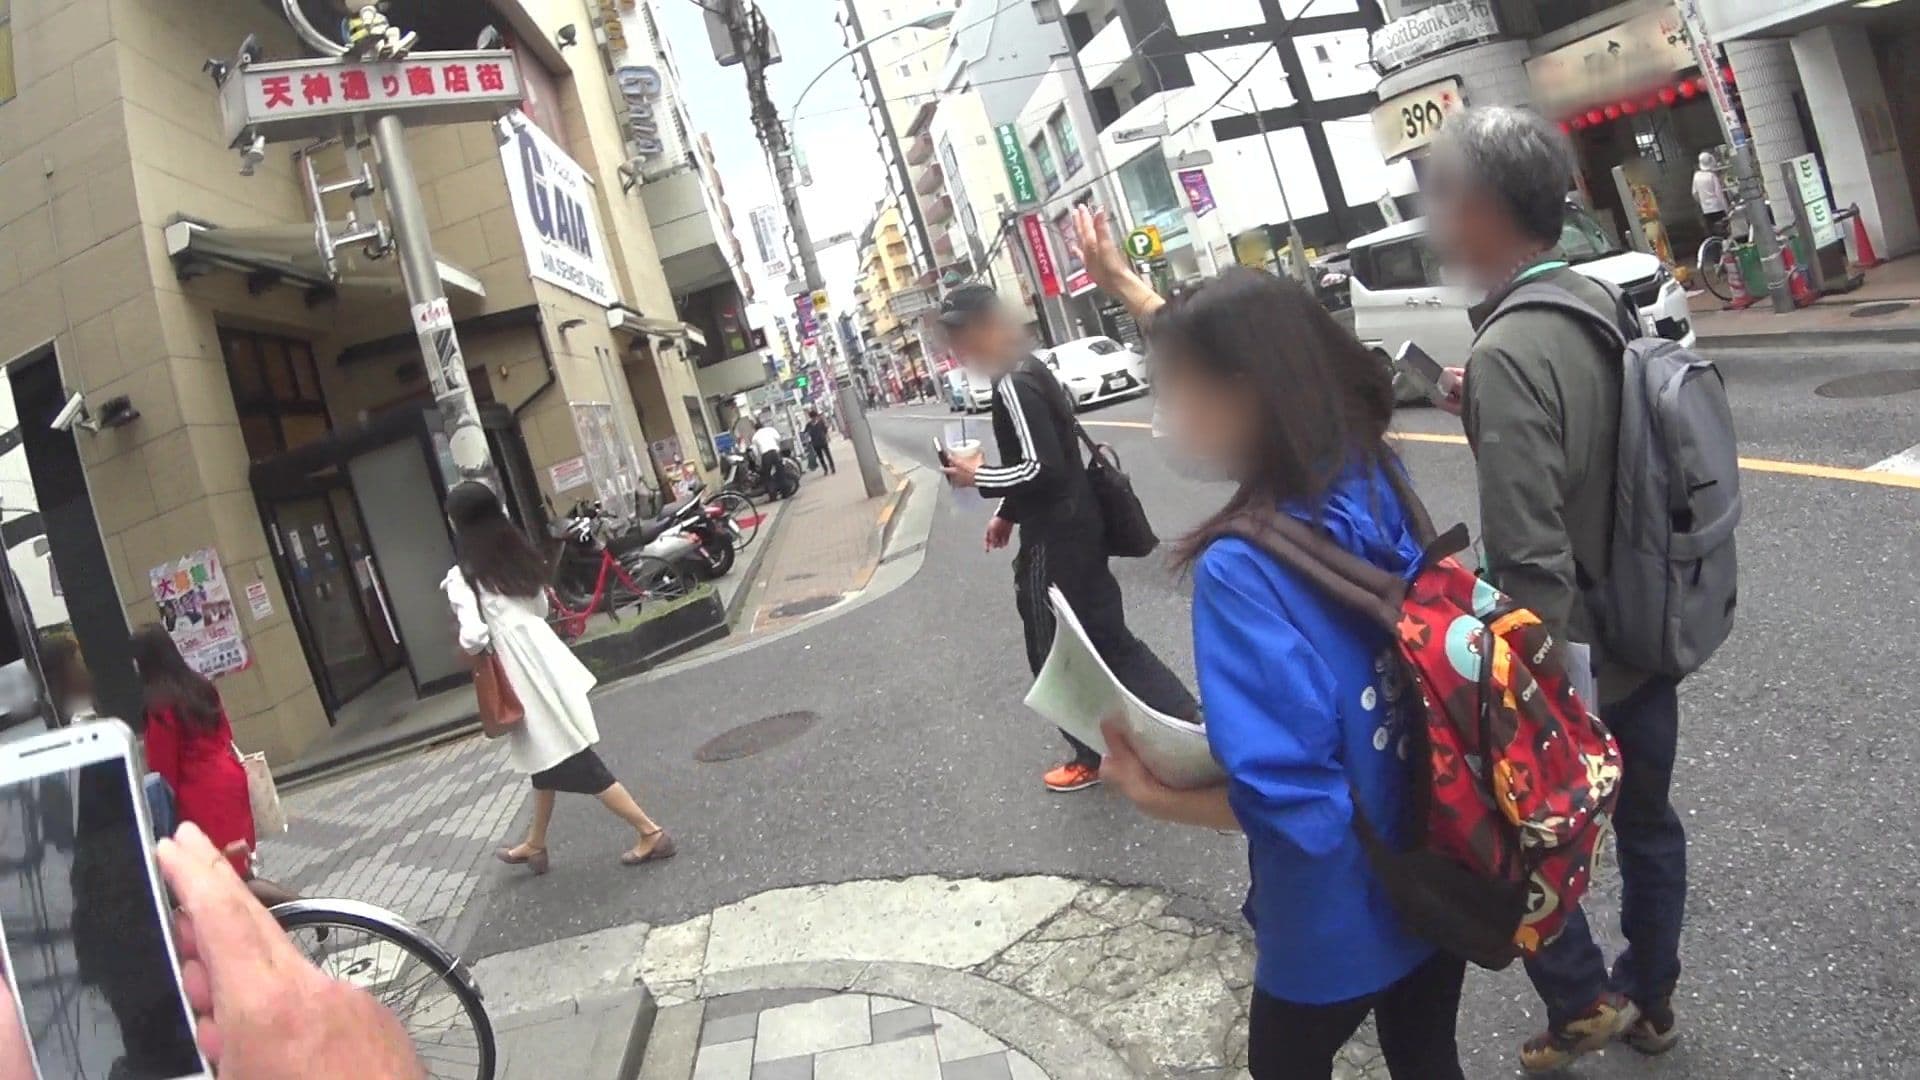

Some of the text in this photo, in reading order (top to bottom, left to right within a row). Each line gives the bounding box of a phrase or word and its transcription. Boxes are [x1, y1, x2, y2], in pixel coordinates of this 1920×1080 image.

[261, 63, 505, 109] 天神通り商店街
[518, 128, 594, 261] GAIA
[1133, 235, 1150, 255] P
